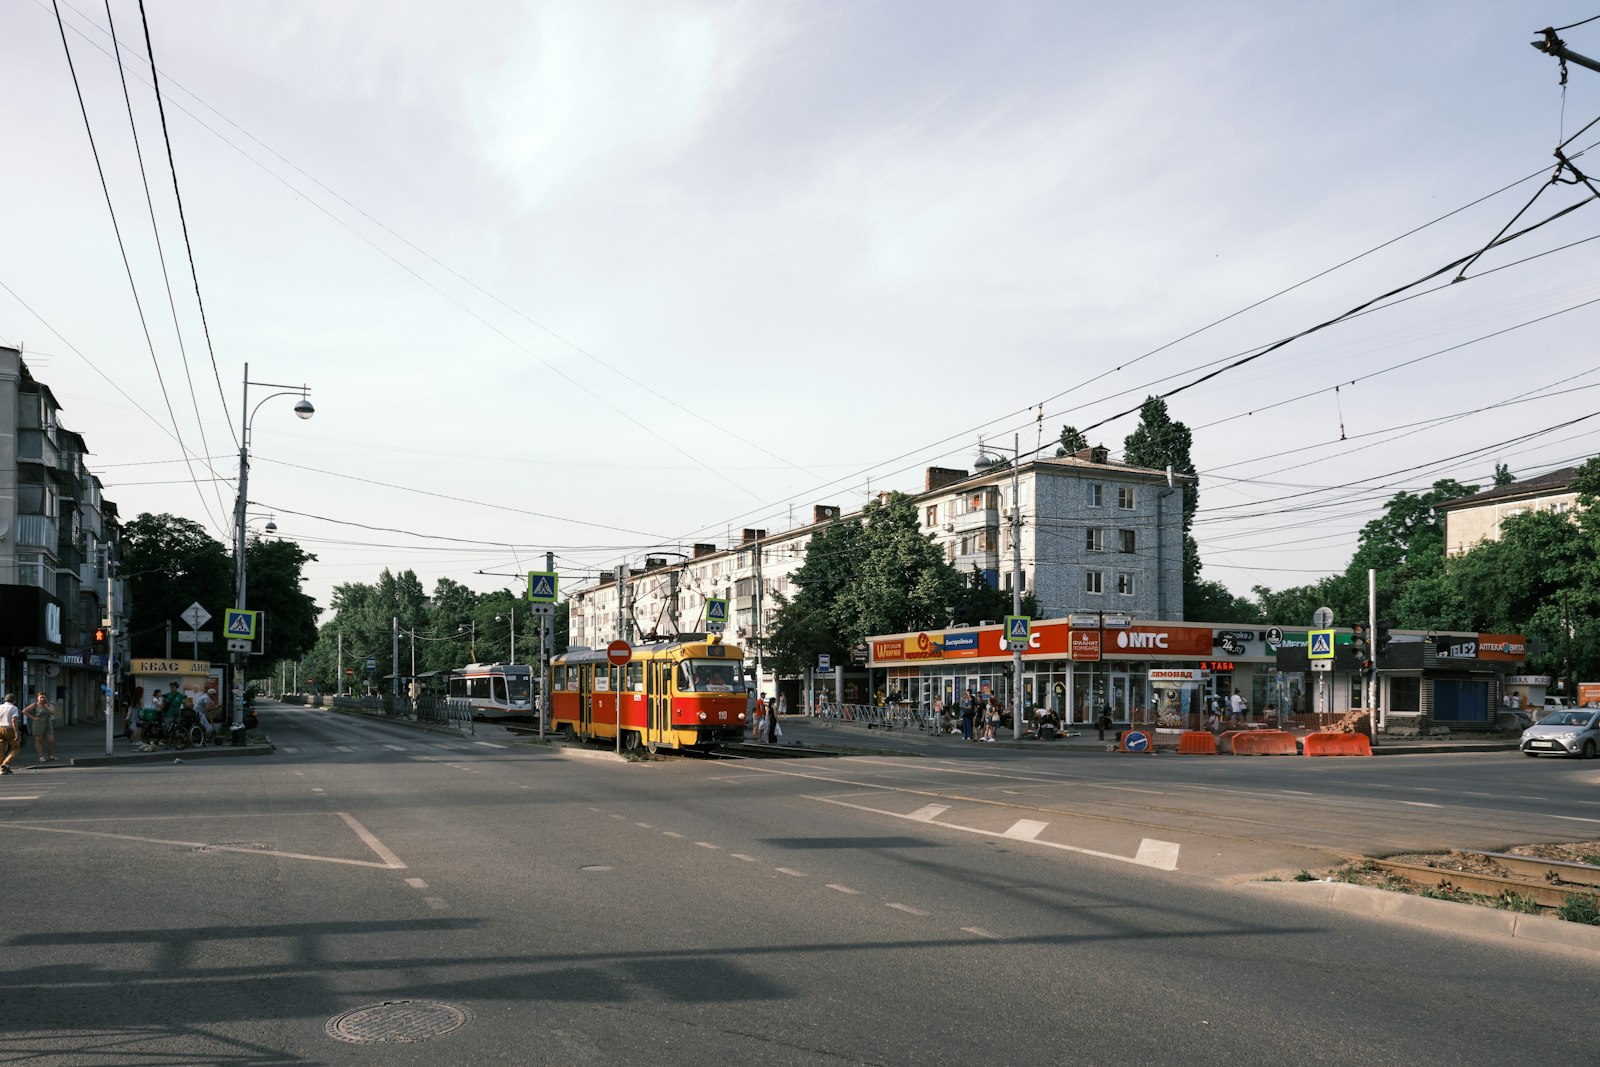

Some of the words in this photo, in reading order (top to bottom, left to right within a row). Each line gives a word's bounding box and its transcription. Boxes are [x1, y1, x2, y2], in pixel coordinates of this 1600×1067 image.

[1129, 632, 1168, 648] МТС
[1222, 638, 1233, 652] 24
[1450, 642, 1475, 657] TELE2
[1479, 643, 1502, 651] АПТЕКА
[1510, 644, 1525, 652] ВИТА
[64, 656, 84, 664] АПТЕКА
[140, 662, 179, 672] КВАС
[718, 711, 728, 720] 110
